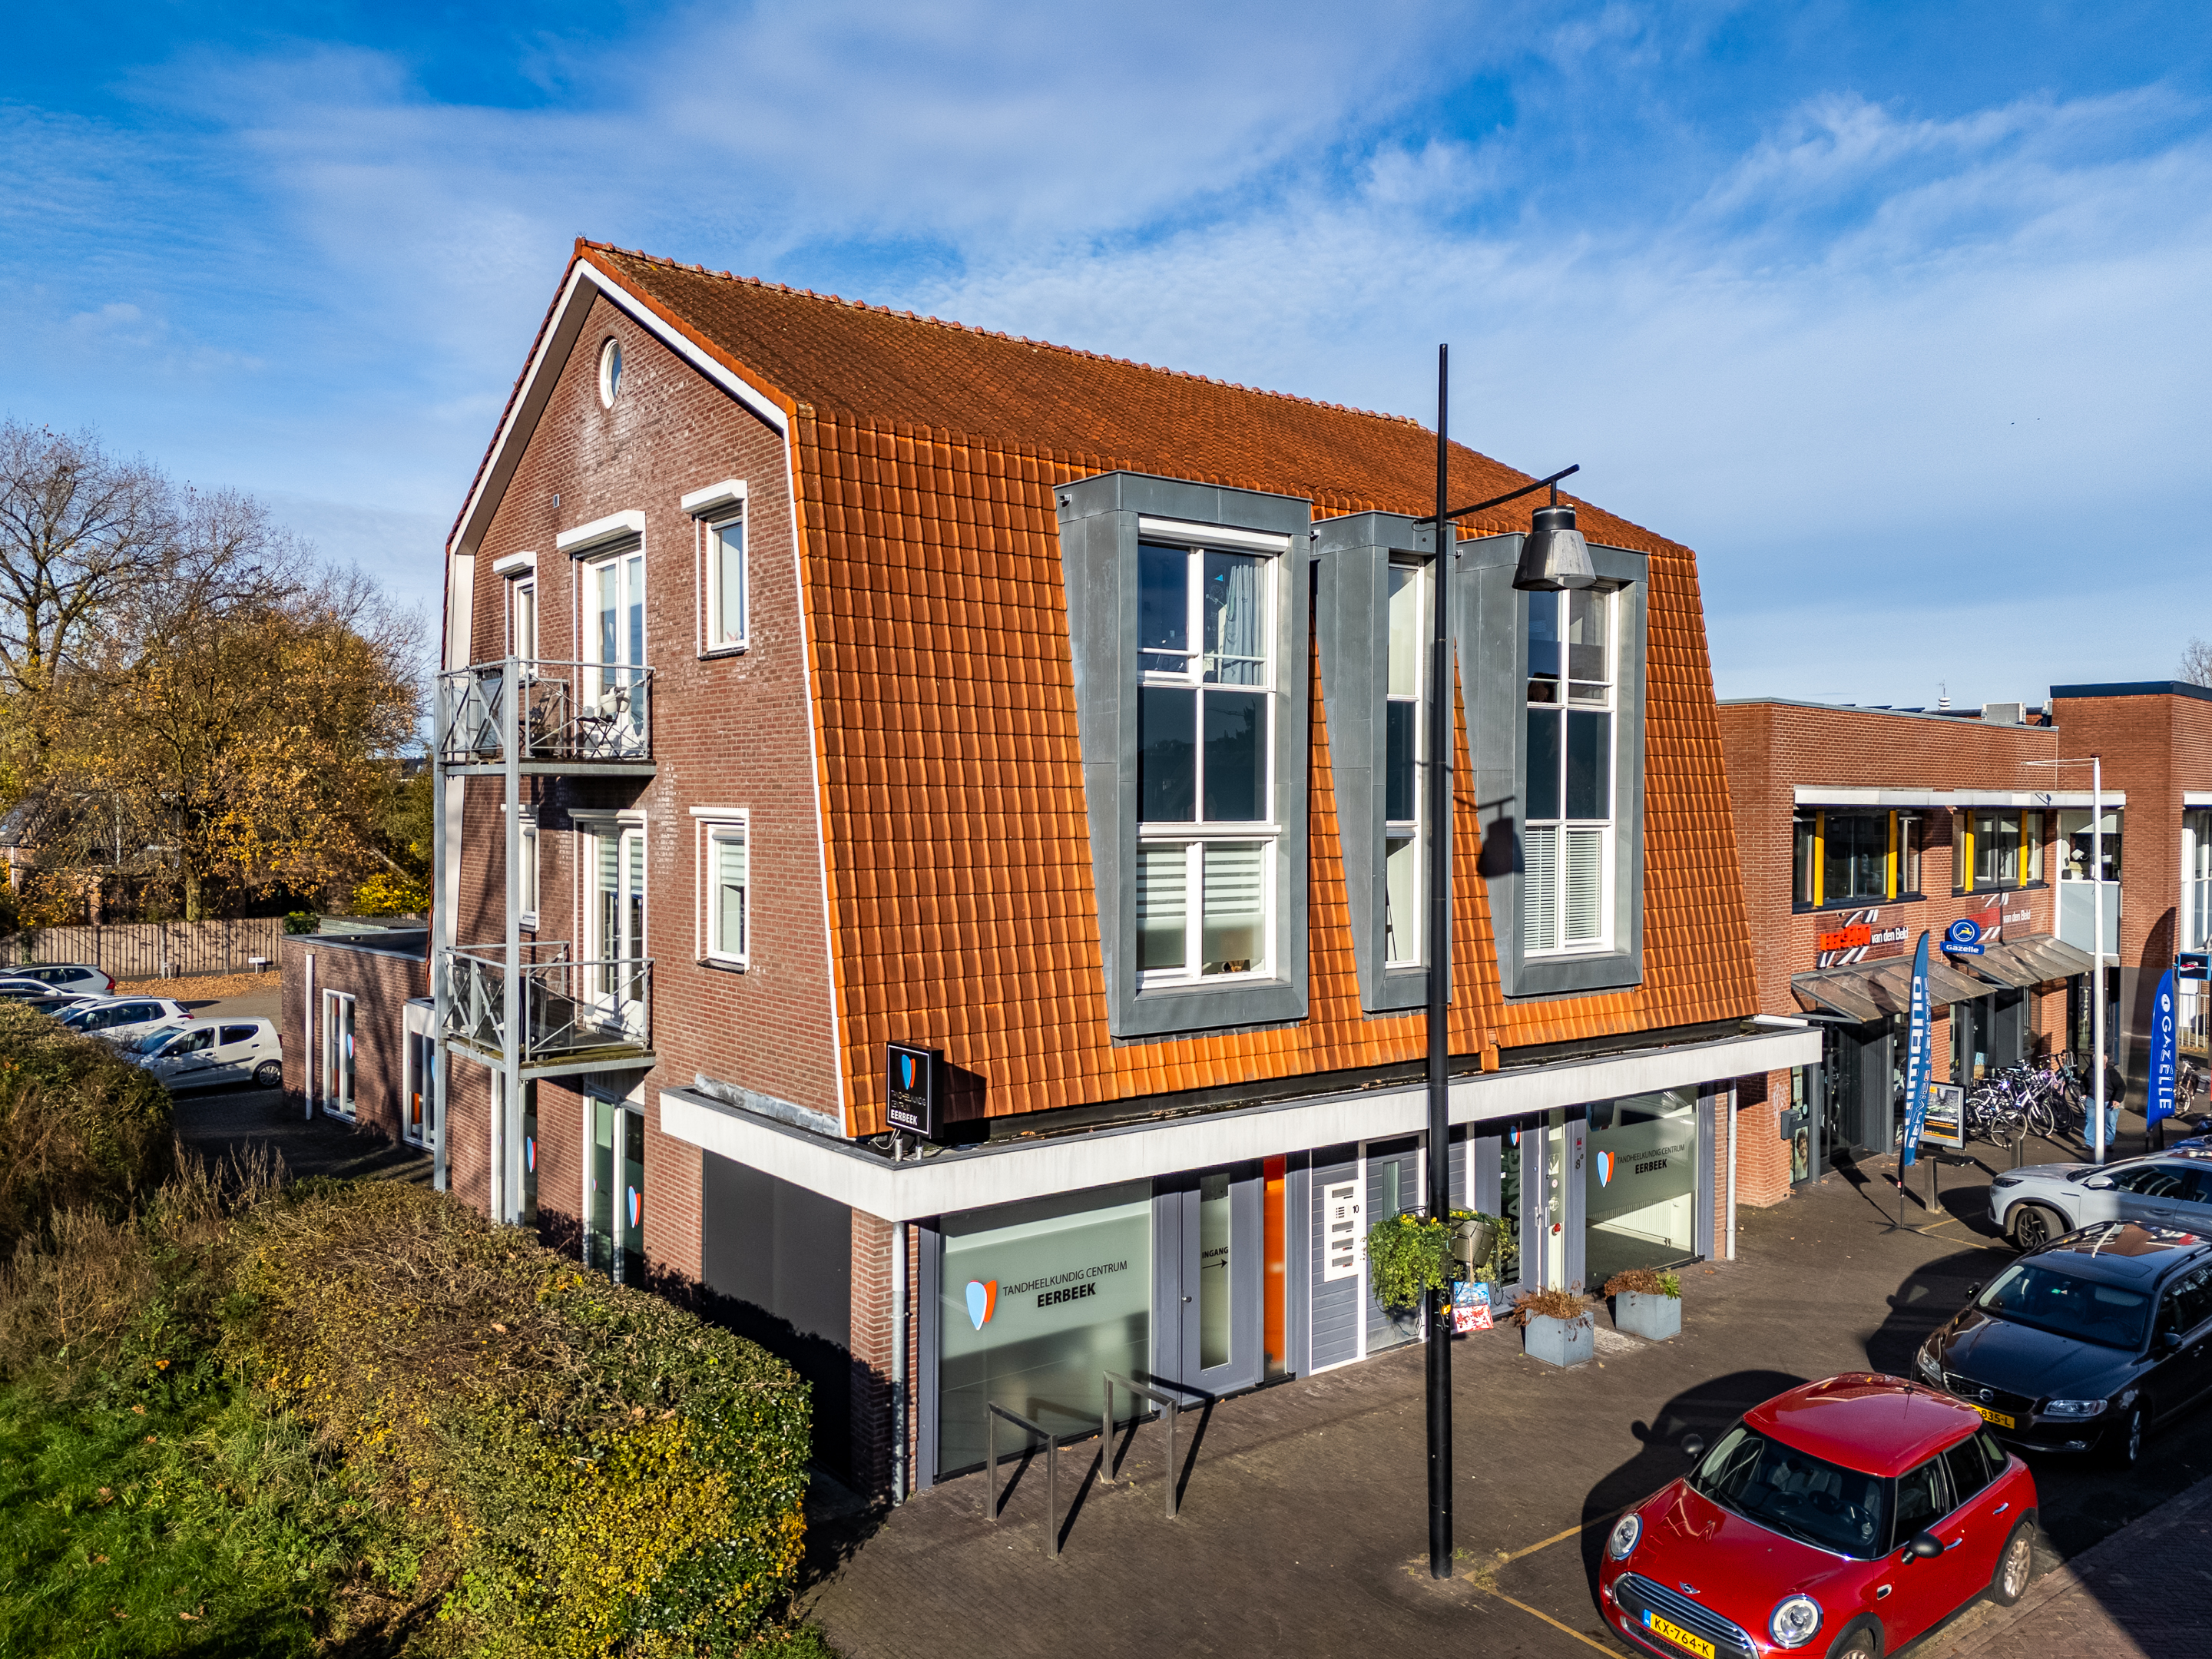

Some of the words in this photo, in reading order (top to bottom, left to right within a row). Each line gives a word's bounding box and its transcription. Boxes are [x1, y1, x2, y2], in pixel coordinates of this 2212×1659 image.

[1871, 934, 1883, 944] van
[1883, 929, 1895, 942] den
[1896, 926, 1909, 940] Beld
[1945, 944, 1979, 953] Gazelle
[2158, 1015, 2174, 1109] GAZELLE
[891, 1109, 918, 1126] EERBEEK
[1617, 1148, 1661, 1164] TANDHEELKUNDIG
[1661, 1144, 1685, 1155] CENTRUM
[1635, 1158, 1667, 1174] EERBEEK
[1353, 1204, 1359, 1214] 10
[1508, 1148, 1520, 1280] INGANG
[1202, 1246, 1228, 1259] INGANG
[1003, 1270, 1084, 1296] TANDHEELKUNDIG
[1086, 1260, 1128, 1278] CENTRUM
[1037, 1282, 1096, 1308] EERBEEK
[1654, 1618, 1709, 1657] KX-764-K
